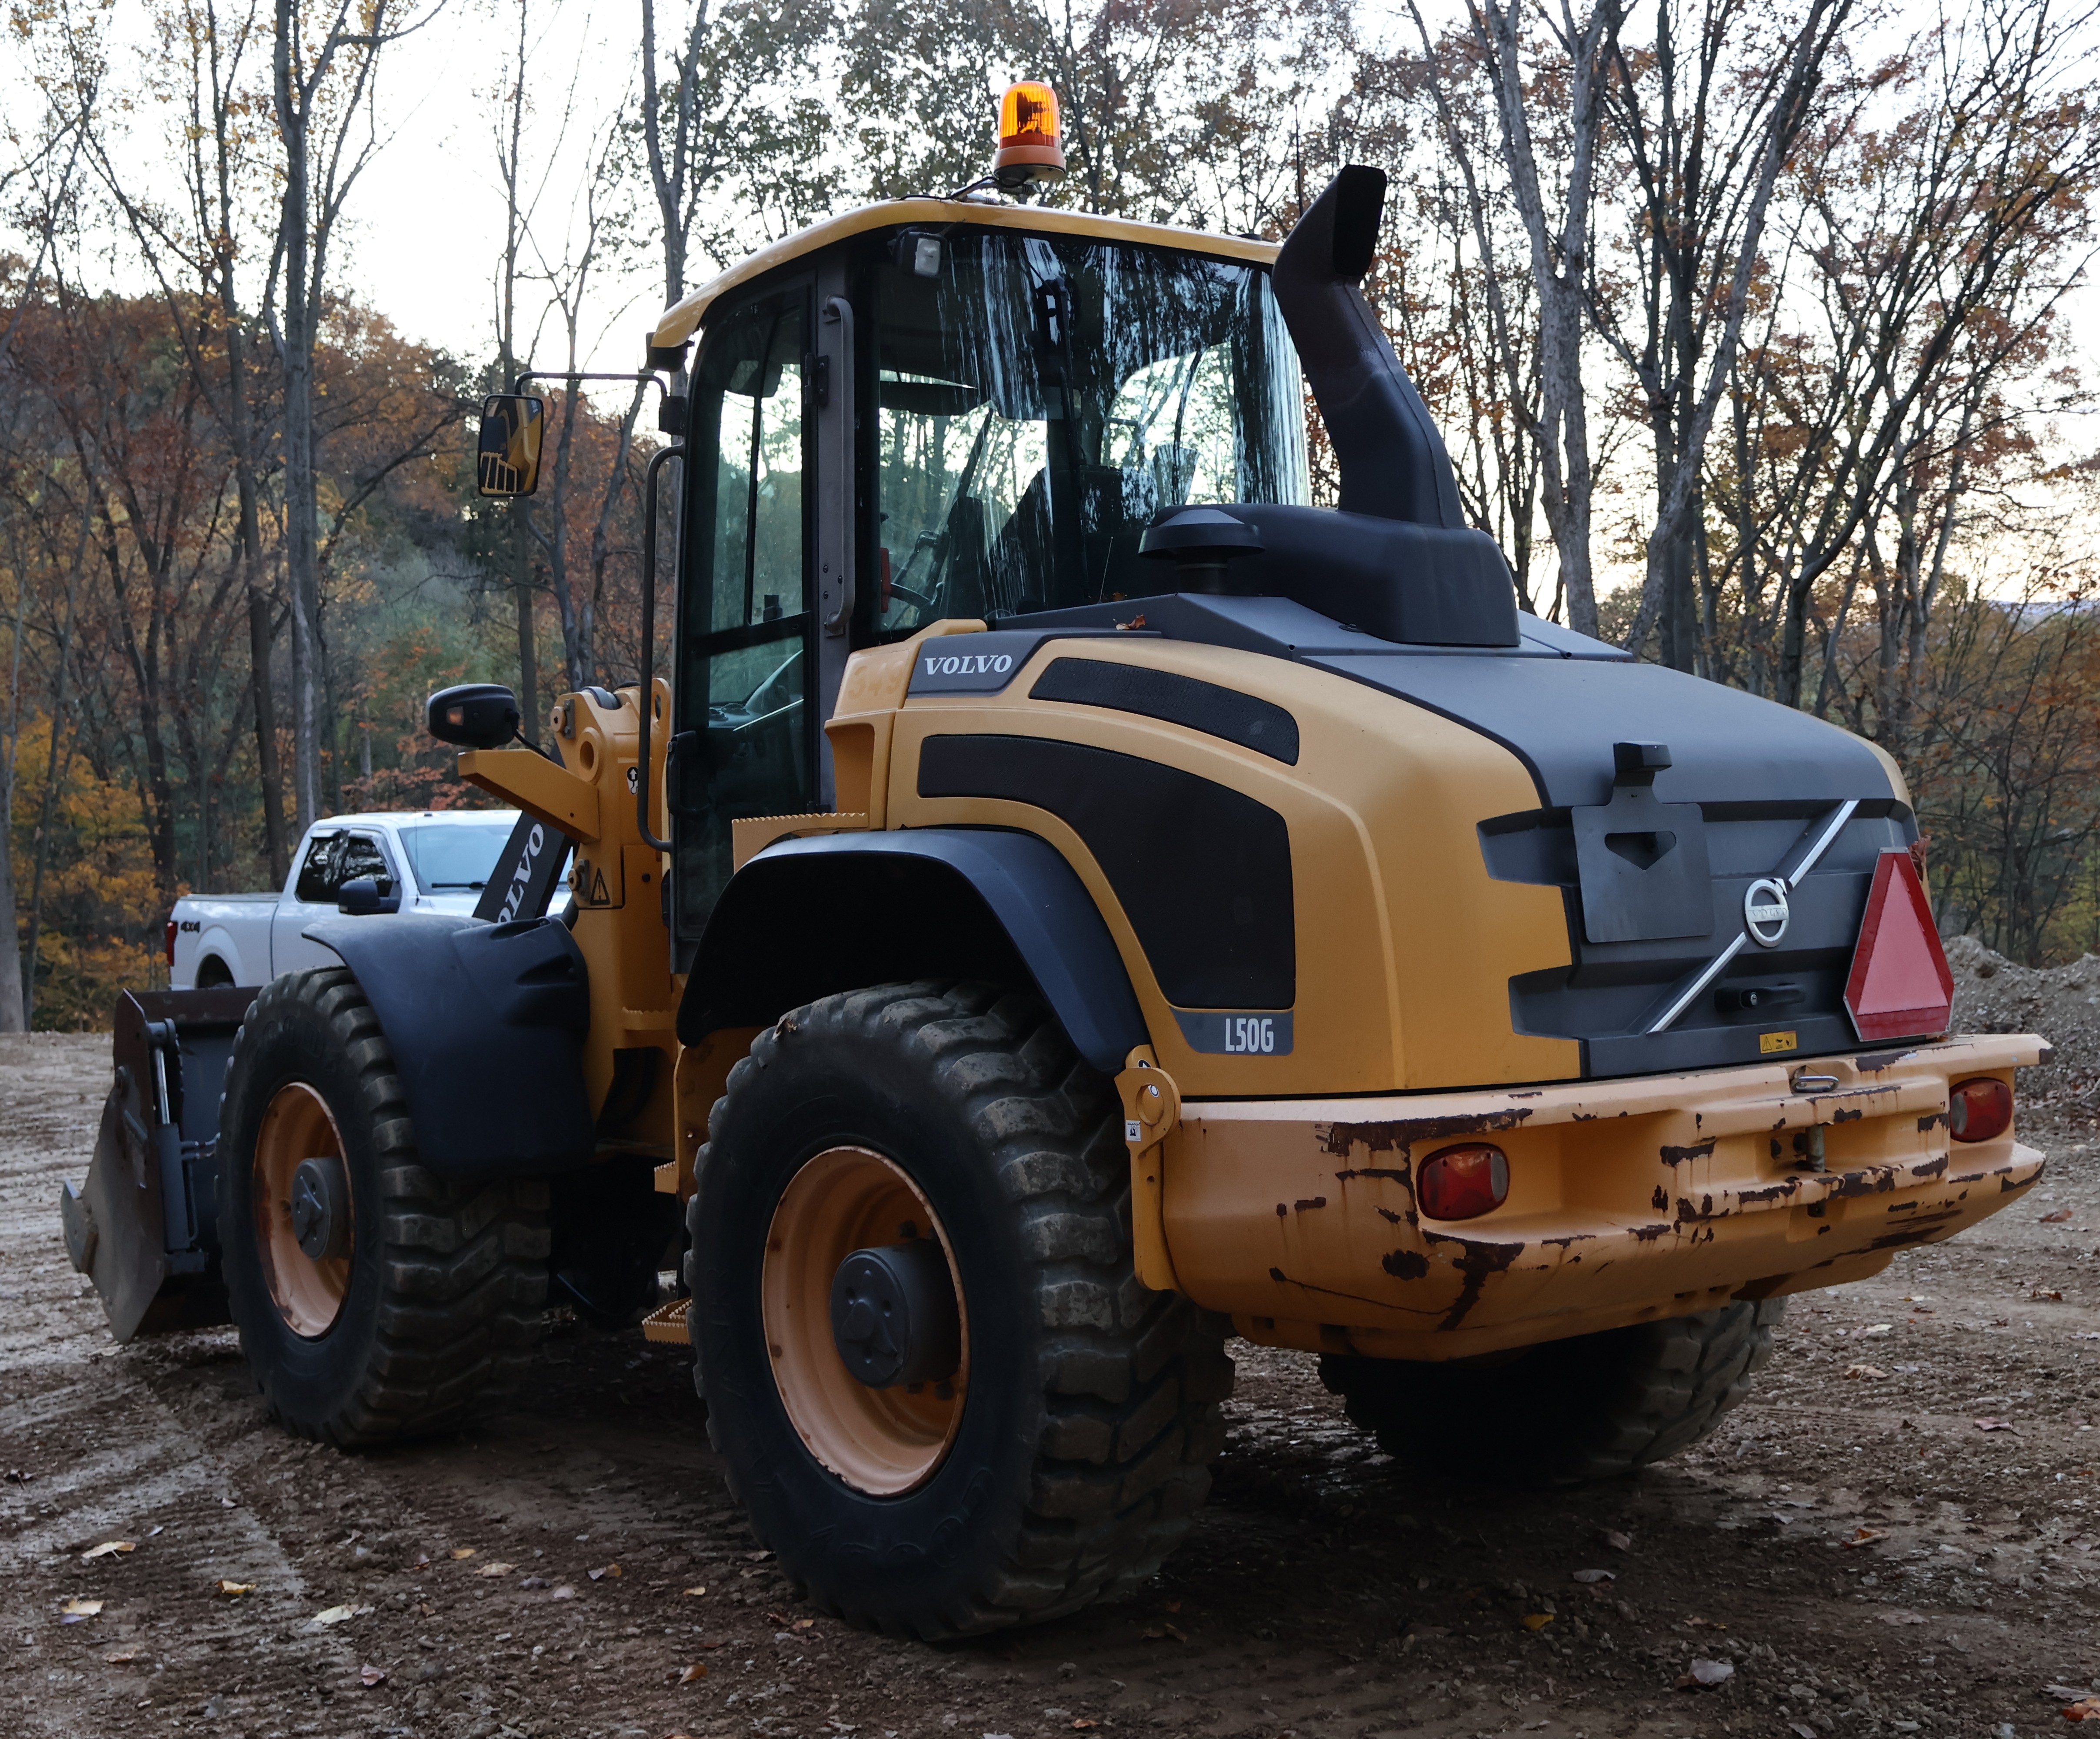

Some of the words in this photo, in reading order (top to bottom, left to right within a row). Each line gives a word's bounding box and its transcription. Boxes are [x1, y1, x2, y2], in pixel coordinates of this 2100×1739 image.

[925, 655, 1012, 675] VOLVO
[498, 823, 544, 924] OLVO
[1748, 908, 1788, 917] VOLVO
[1225, 1018, 1274, 1053] L50G
